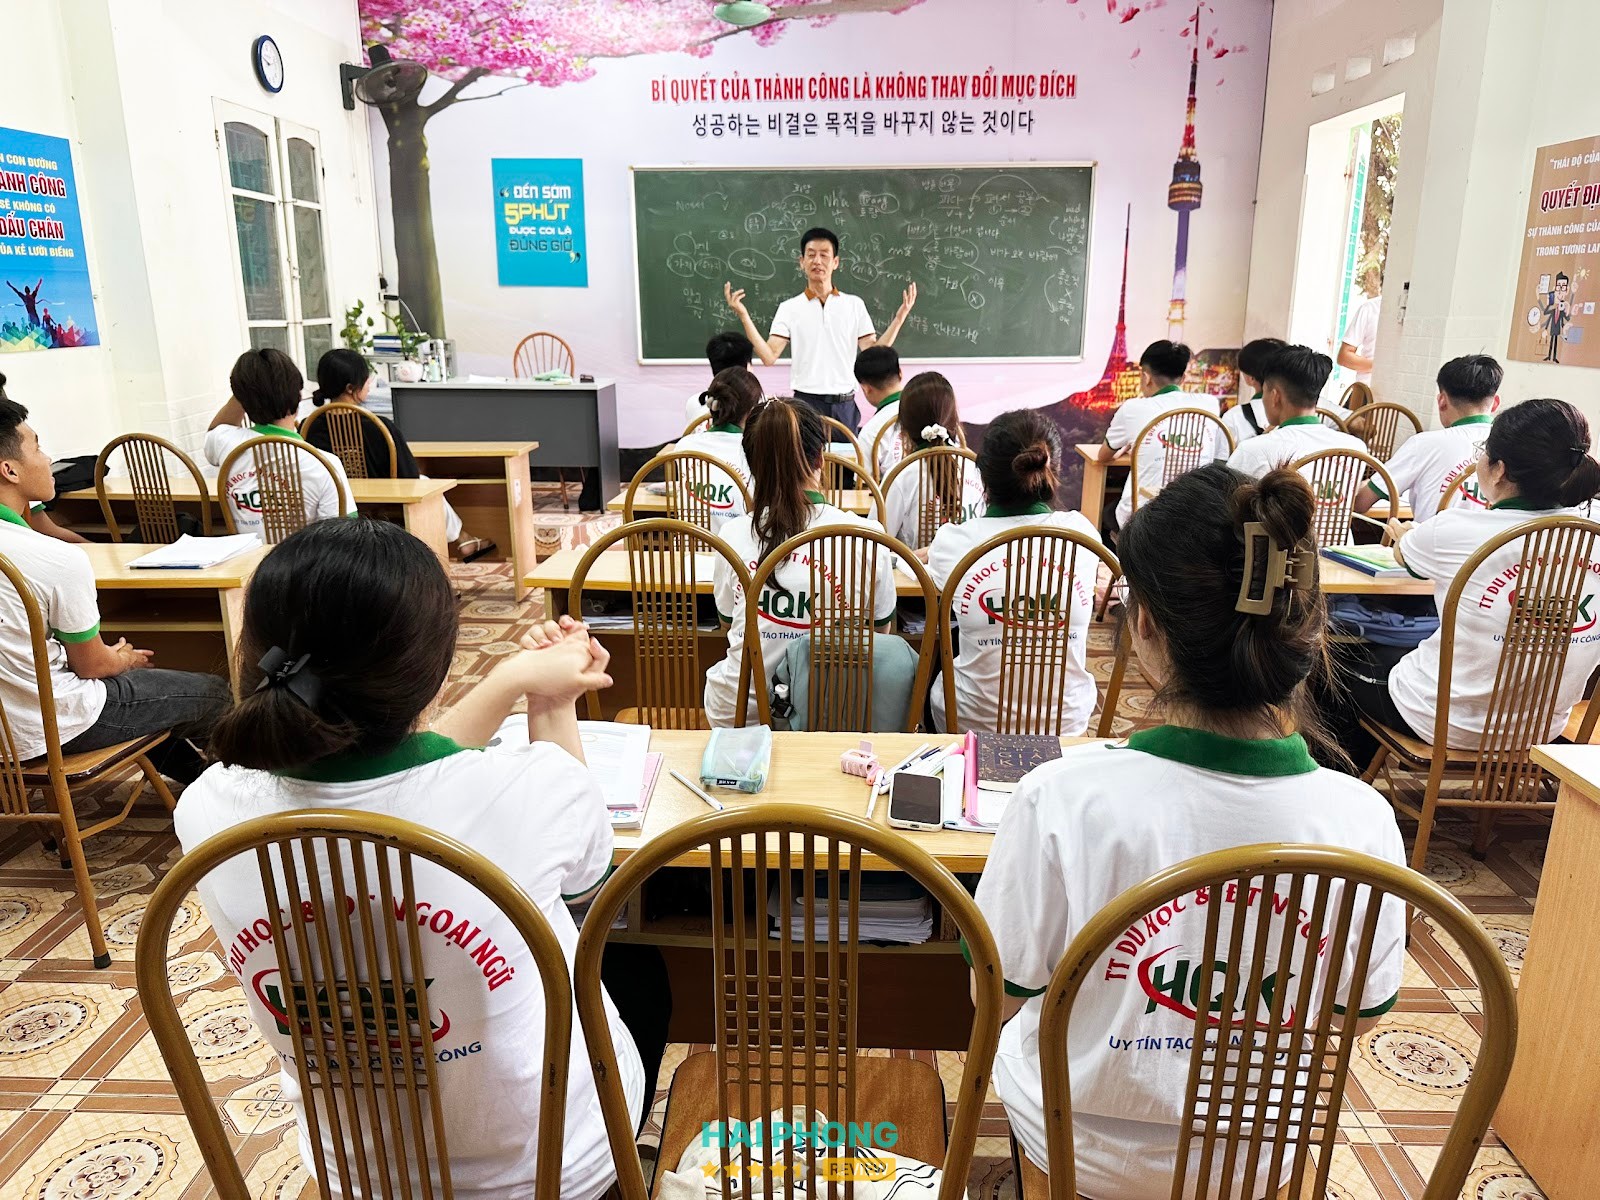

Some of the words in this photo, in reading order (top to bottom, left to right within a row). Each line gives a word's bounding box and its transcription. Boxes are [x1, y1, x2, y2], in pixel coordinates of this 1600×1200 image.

[671, 71, 716, 104] QUYẾT
[721, 70, 750, 101] CỦA
[755, 72, 804, 100] THÀNH
[808, 72, 849, 100] CÔNG
[853, 72, 871, 99] LÀ
[876, 71, 926, 98] KHÔNG
[932, 75, 968, 98] THAY
[972, 66, 997, 97] ĐỔI
[1002, 74, 1035, 102] MỤC
[1040, 70, 1076, 97] ĐÍCH
[692, 113, 760, 137] 성공하는
[768, 112, 818, 136] 비결은
[825, 111, 876, 135] 목적을
[884, 110, 933, 134] 바꾸지
[942, 110, 974, 134] 않는
[982, 109, 1034, 133] 것이다
[6, 154, 26, 166] CON
[29, 172, 66, 197] CÔNG
[1541, 181, 1581, 212] QUYẾT
[13, 200, 42, 212] KHÔNG
[44, 203, 56, 213] CÓ
[28, 217, 64, 239] CHÂN
[1539, 225, 1562, 237] THÀNH
[1564, 222, 1585, 235] CÔNG
[1536, 246, 1560, 257] TRONG
[964, 584, 976, 601] DU
[1479, 594, 1494, 610] TT
[1487, 578, 1506, 595] DU
[1142, 896, 1187, 938] HỌC
[1115, 925, 1145, 957] DU
[469, 937, 513, 992] NGỮ
[1104, 957, 1130, 981] TT
[1109, 1035, 1132, 1051] UY
[1136, 1035, 1162, 1050] TÍN
